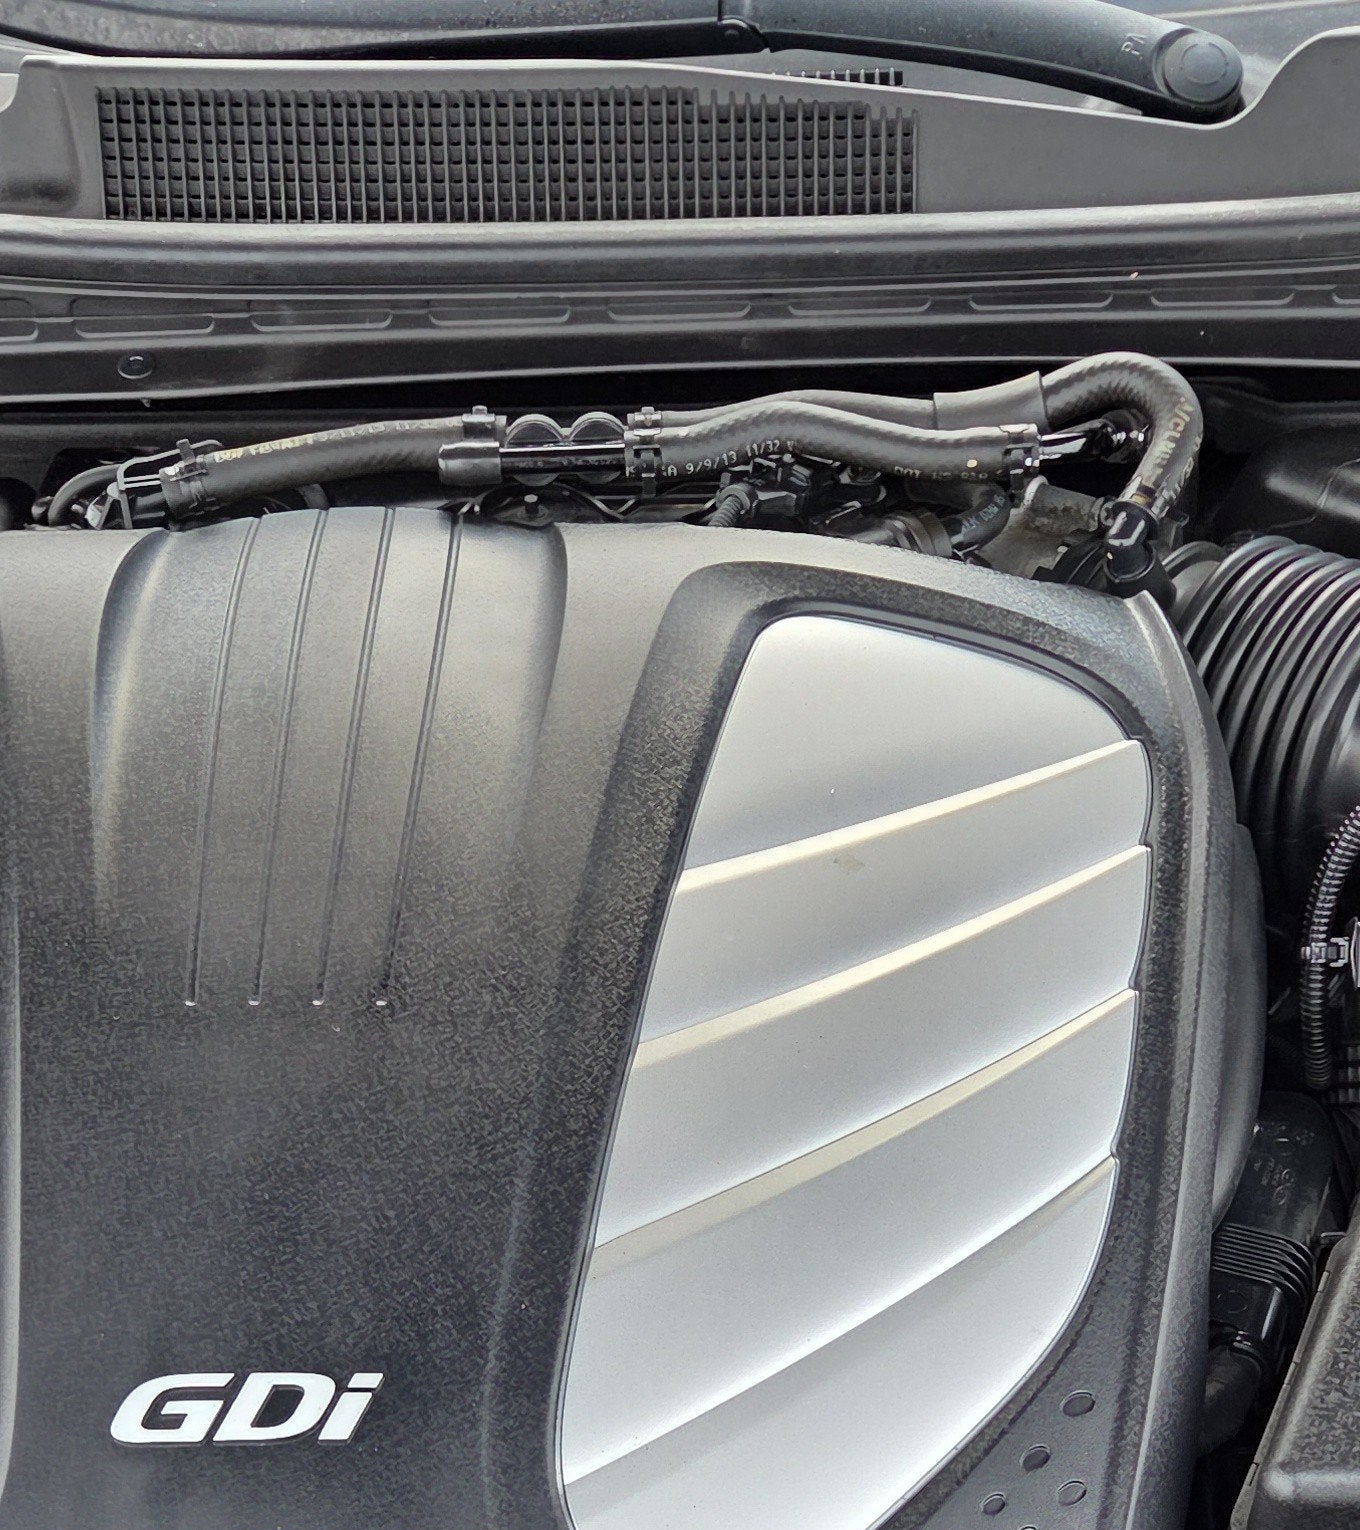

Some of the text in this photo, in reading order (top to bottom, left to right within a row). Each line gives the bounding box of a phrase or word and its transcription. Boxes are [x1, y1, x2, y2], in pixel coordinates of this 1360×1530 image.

[685, 450, 738, 475] 9/9/13
[745, 439, 781, 458] 11/32
[109, 1371, 385, 1445] GDi
